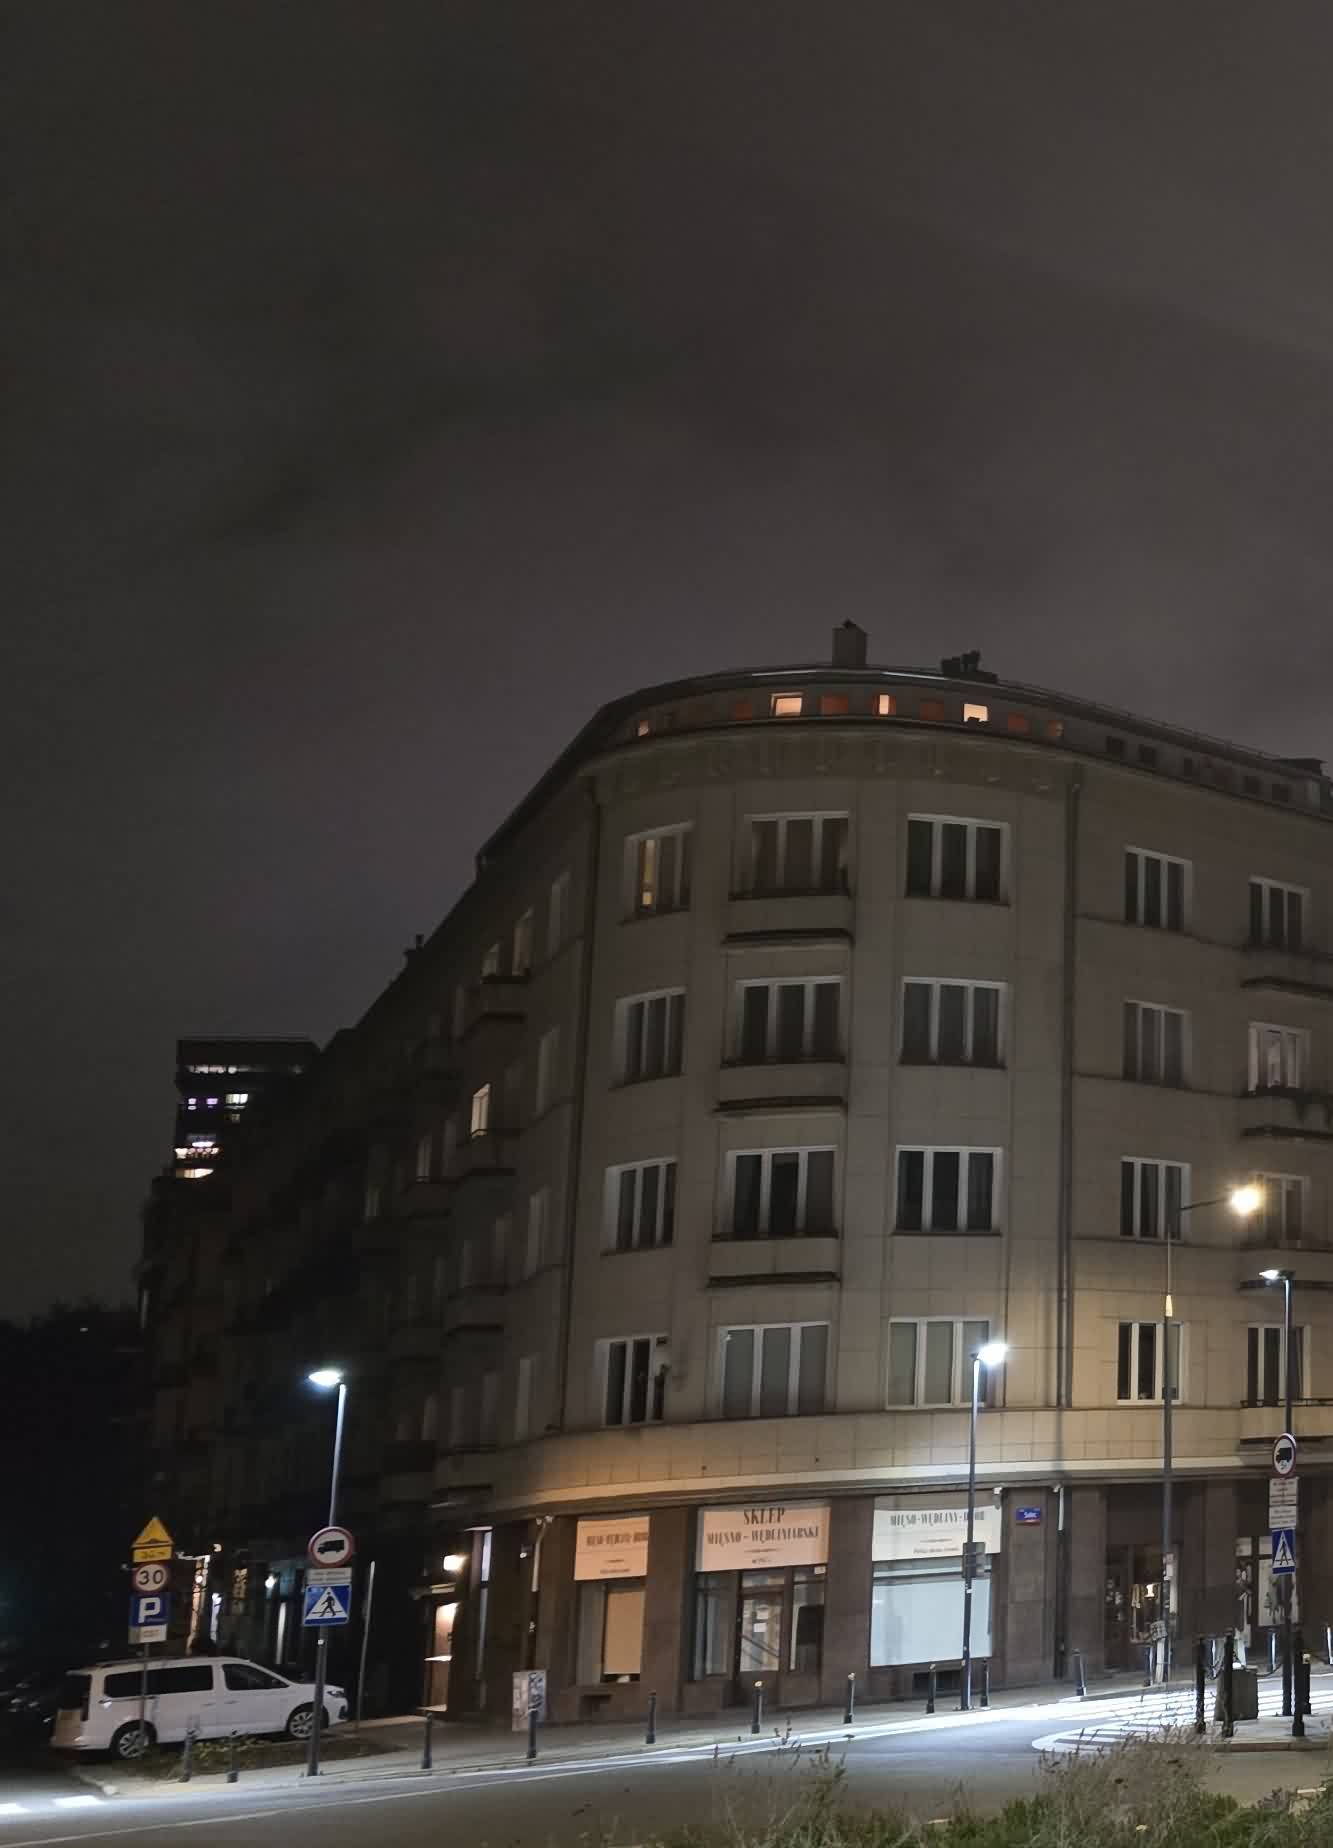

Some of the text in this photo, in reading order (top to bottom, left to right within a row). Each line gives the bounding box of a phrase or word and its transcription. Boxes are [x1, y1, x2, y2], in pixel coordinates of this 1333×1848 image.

[743, 1507, 785, 1526] SKLEP
[139, 1569, 164, 1586] 30
[138, 1597, 161, 1624] P
